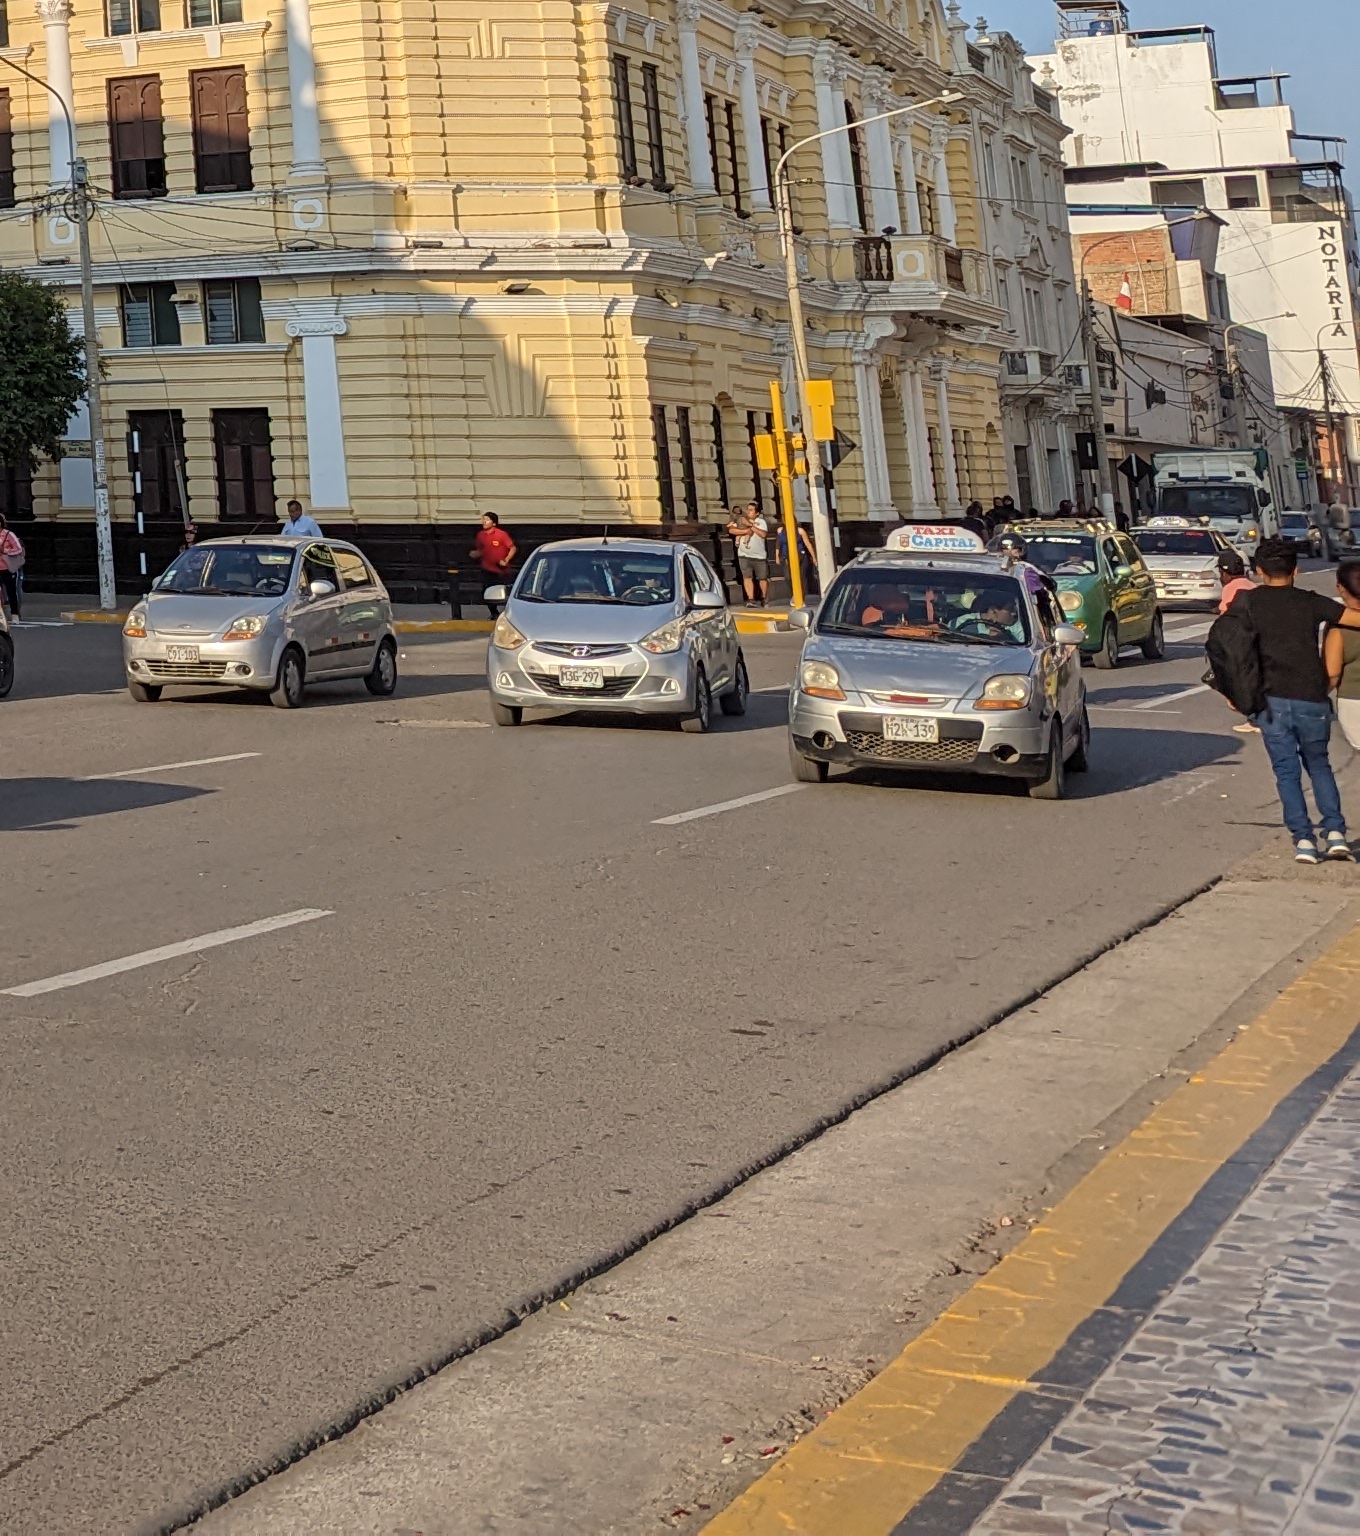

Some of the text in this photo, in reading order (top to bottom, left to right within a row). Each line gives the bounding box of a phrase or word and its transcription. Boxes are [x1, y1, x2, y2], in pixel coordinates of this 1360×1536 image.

[1318, 226, 1347, 336] NOTARIA
[912, 527, 955, 535] TAXI
[561, 671, 599, 682] M3G-297
